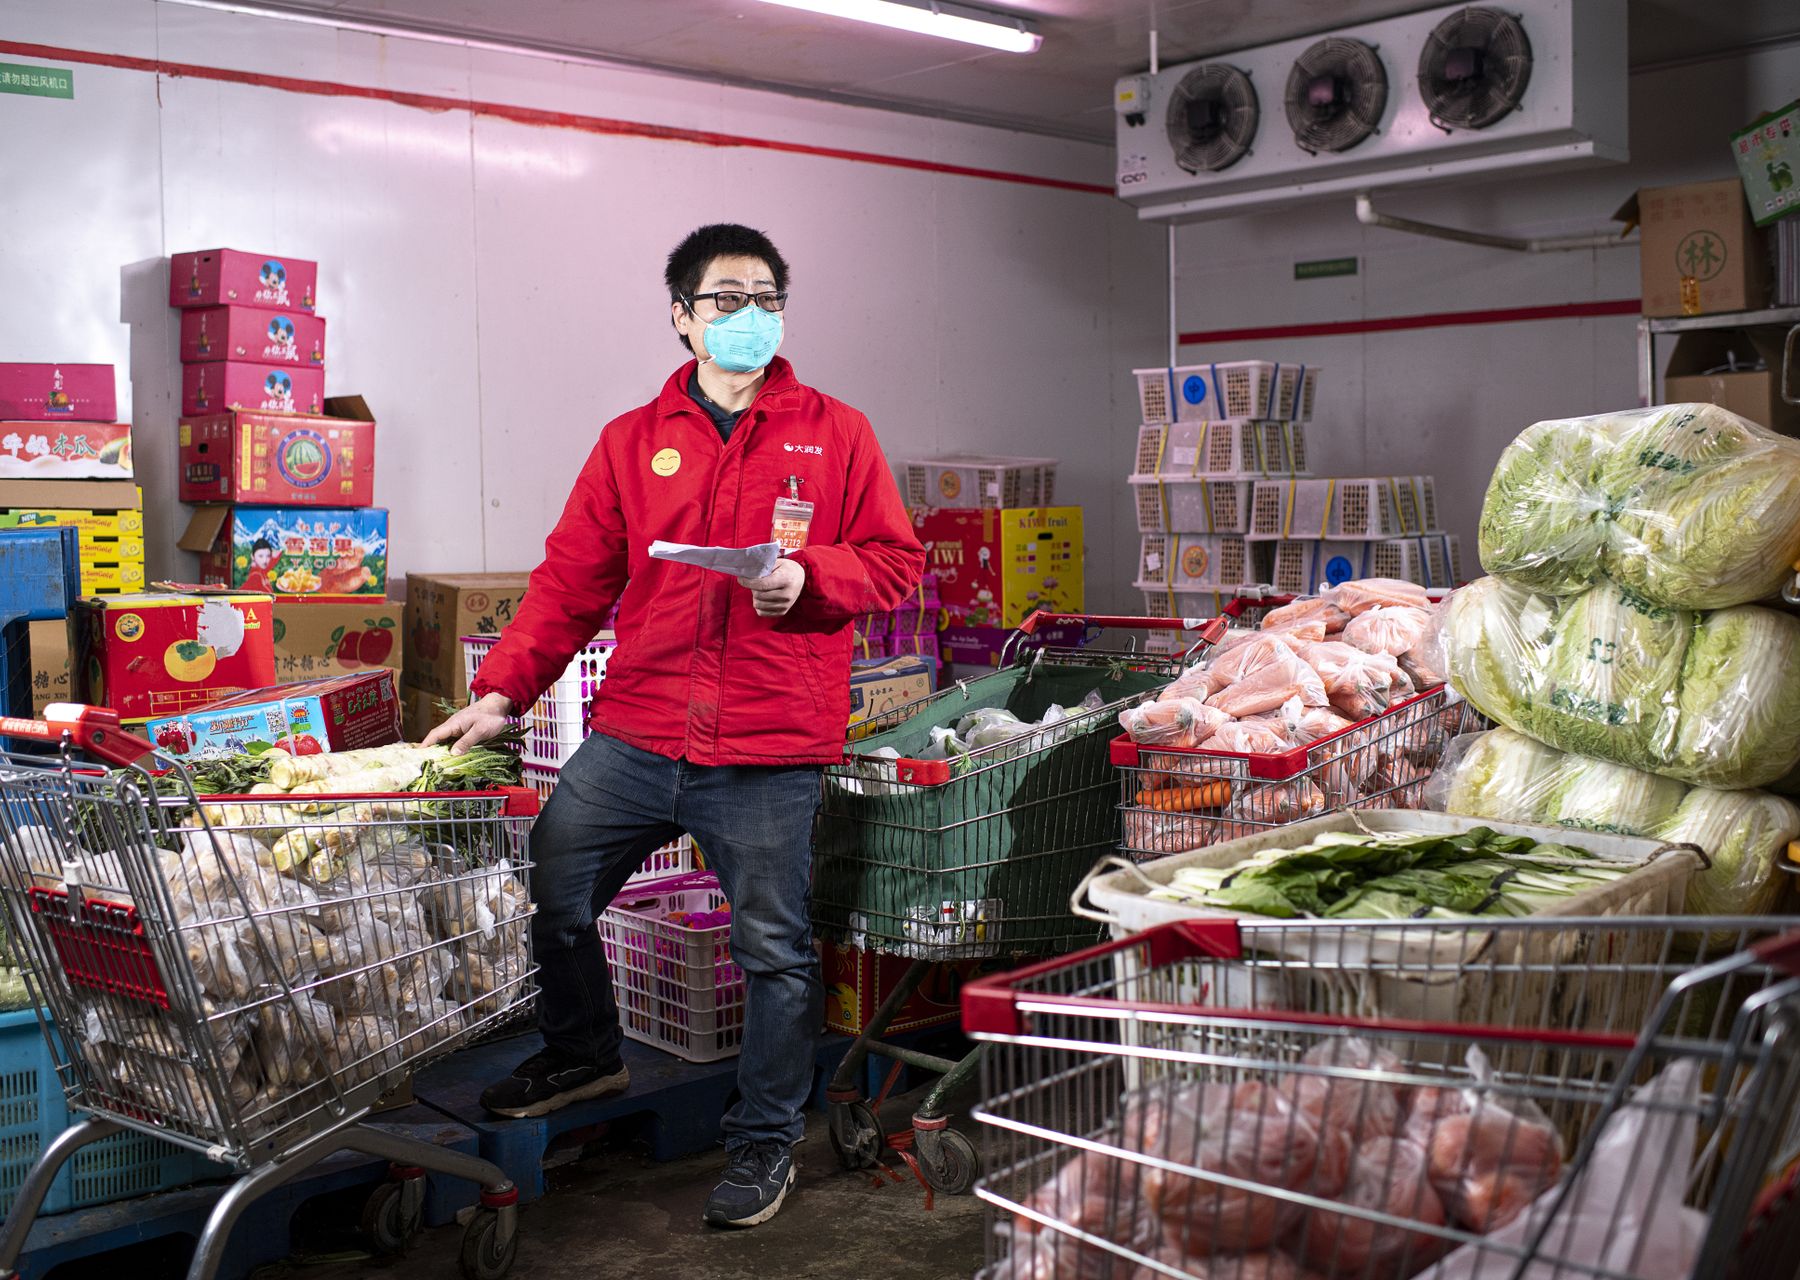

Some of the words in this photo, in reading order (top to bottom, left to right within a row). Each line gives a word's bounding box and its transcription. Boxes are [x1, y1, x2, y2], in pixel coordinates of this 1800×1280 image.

[0, 71, 67, 89] 请勿超出风机口
[1684, 235, 1720, 275] 林
[795, 444, 823, 456] 大润发
[21, 514, 37, 523] NEW
[775, 538, 801, 548] 02712
[34, 671, 69, 689] 糖心
